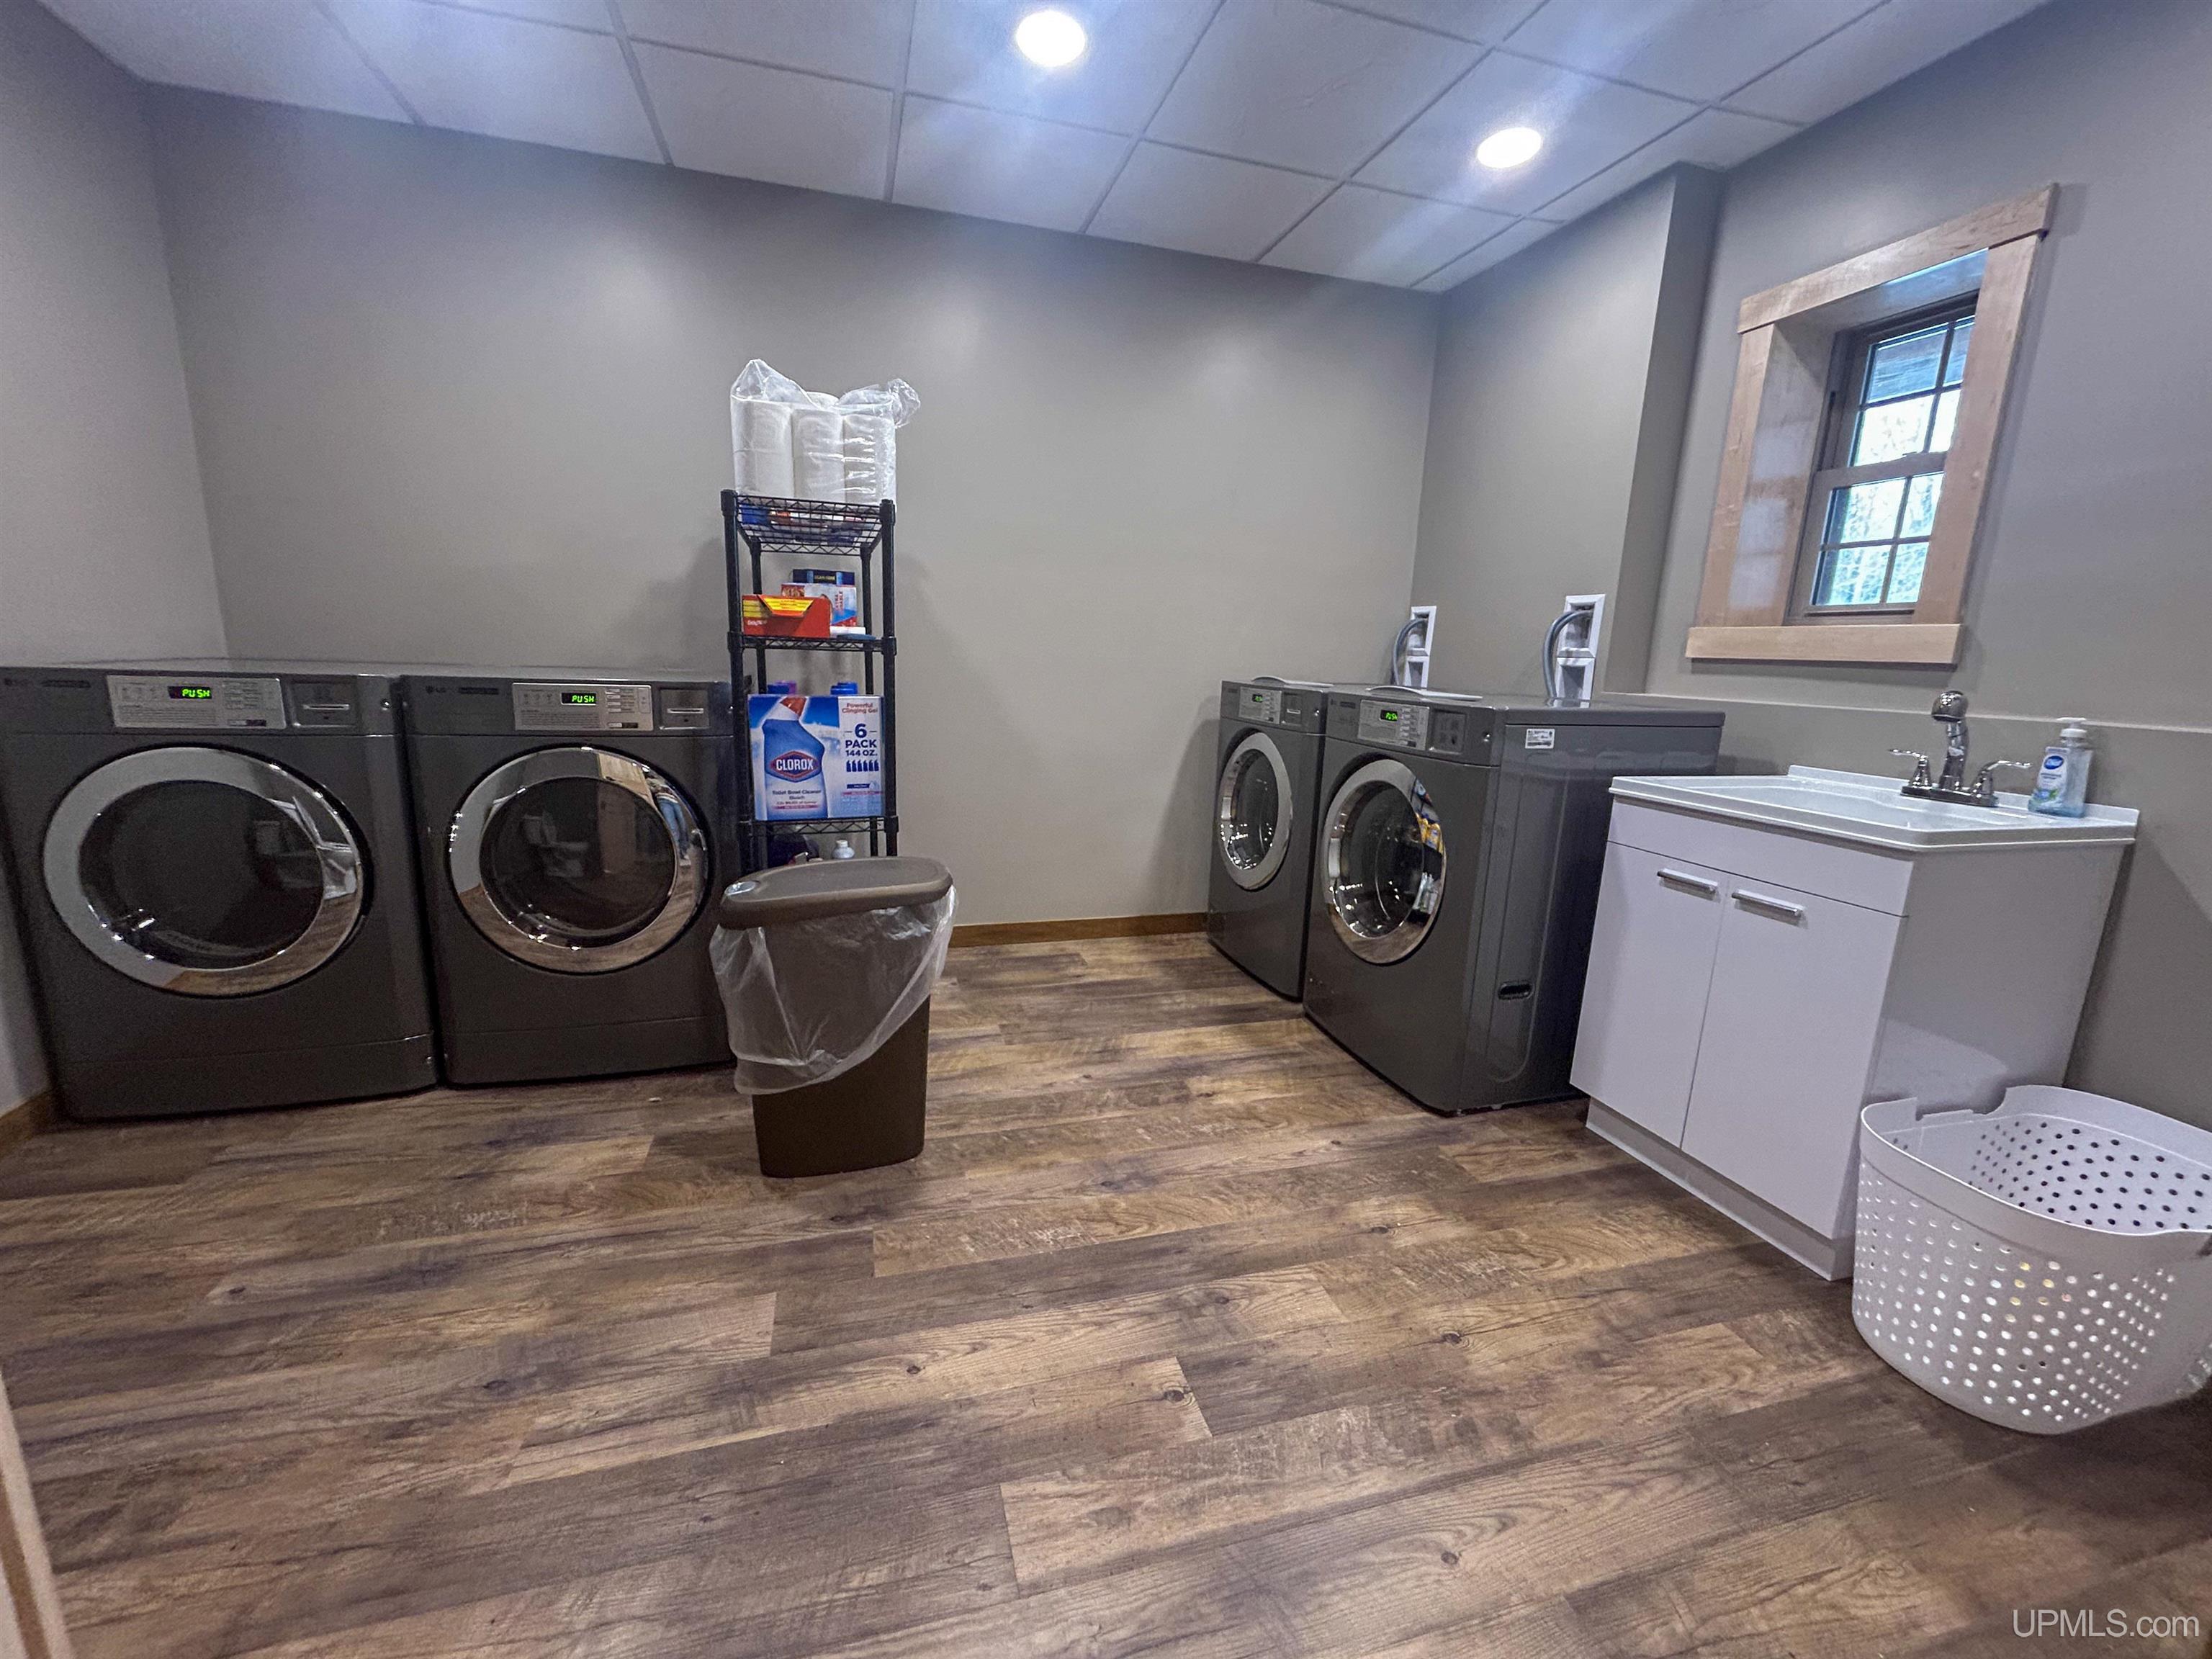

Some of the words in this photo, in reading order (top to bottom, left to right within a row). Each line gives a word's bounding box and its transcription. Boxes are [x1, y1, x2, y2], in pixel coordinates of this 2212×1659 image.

[181, 688, 210, 698] PUSH
[855, 723, 868, 738] 6
[845, 739, 877, 748] PACK
[776, 758, 814, 770] CLOROX
